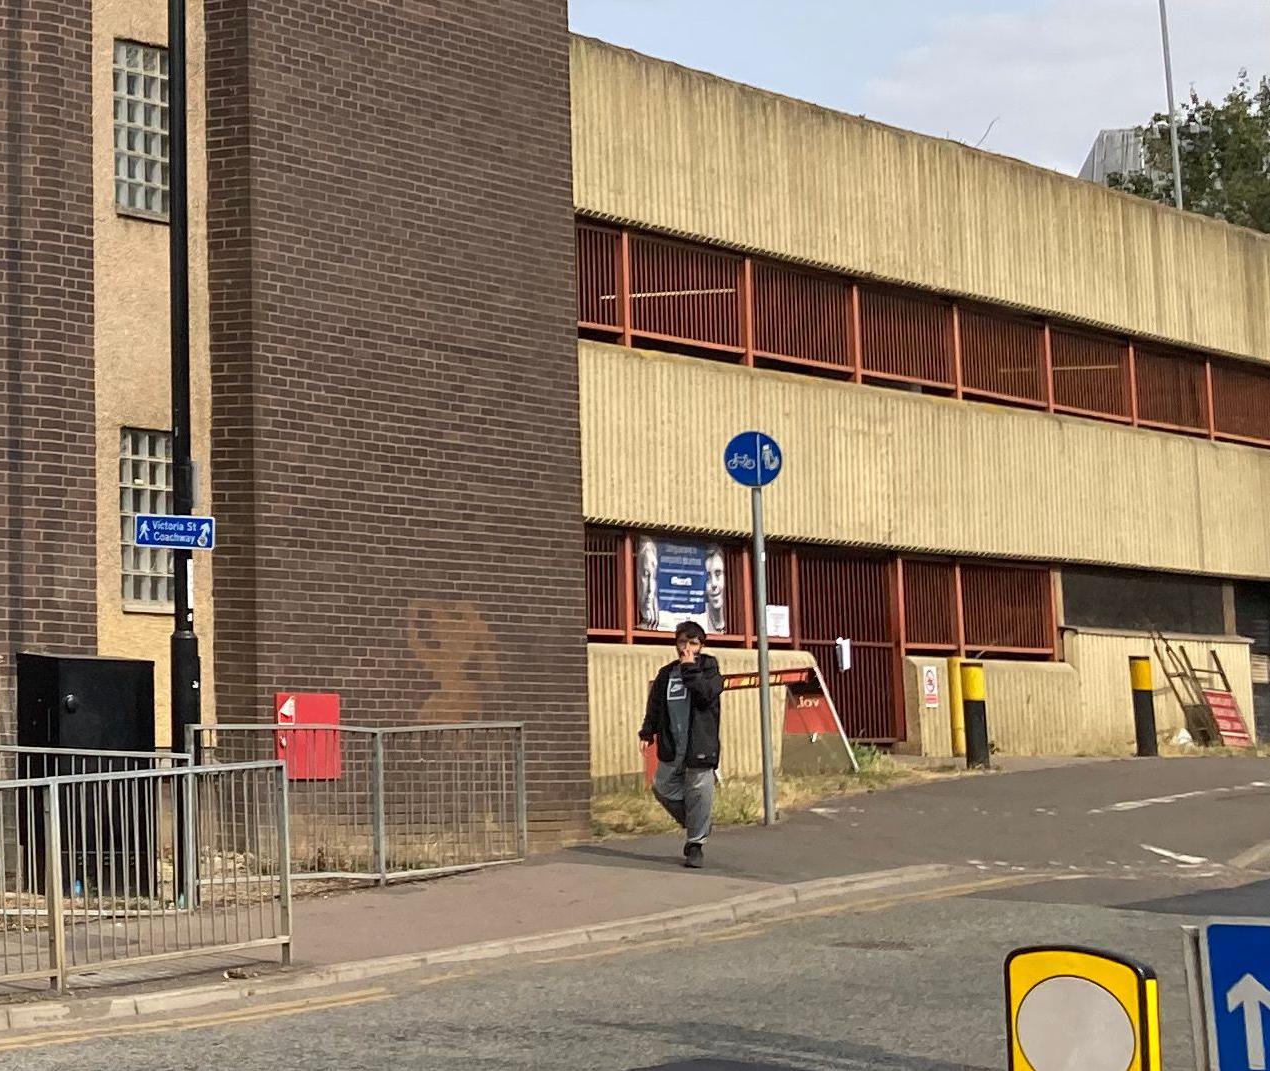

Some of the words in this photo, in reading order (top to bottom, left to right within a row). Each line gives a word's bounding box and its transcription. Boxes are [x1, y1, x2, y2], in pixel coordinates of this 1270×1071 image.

[152, 520, 184, 531] Victoria
[186, 521, 197, 532] St
[153, 531, 196, 545] Coachway
